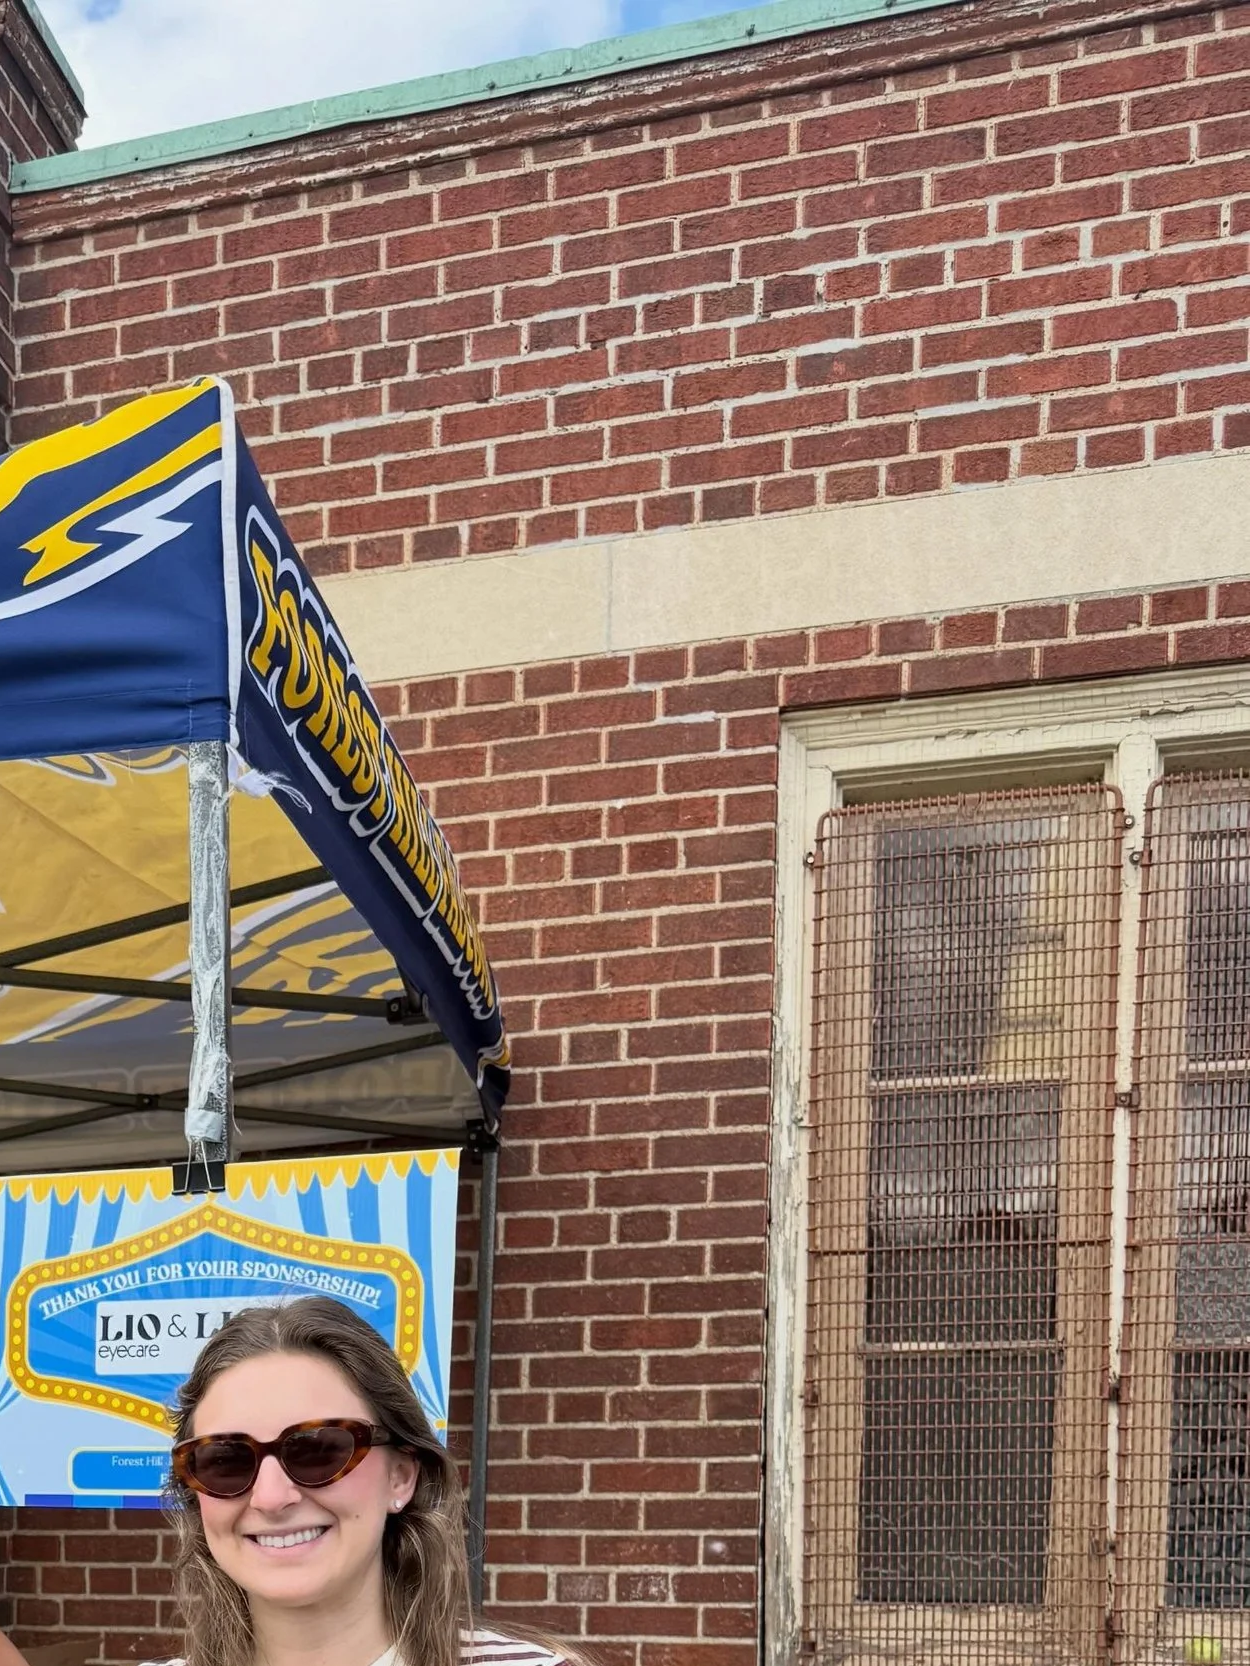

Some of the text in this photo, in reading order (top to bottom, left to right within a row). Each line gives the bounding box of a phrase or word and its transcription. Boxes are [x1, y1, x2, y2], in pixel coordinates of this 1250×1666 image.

[250, 539, 387, 821] FOREST
[384, 743, 442, 902] HILL
[38, 1260, 382, 1319] THANK YOU FOR YOUR SPONSORSHIP!
[100, 1313, 161, 1341] LIO
[167, 1314, 187, 1338] &
[98, 1344, 160, 1361] eyecare
[111, 1455, 144, 1466] Forest
[145, 1455, 163, 1466] Hill
